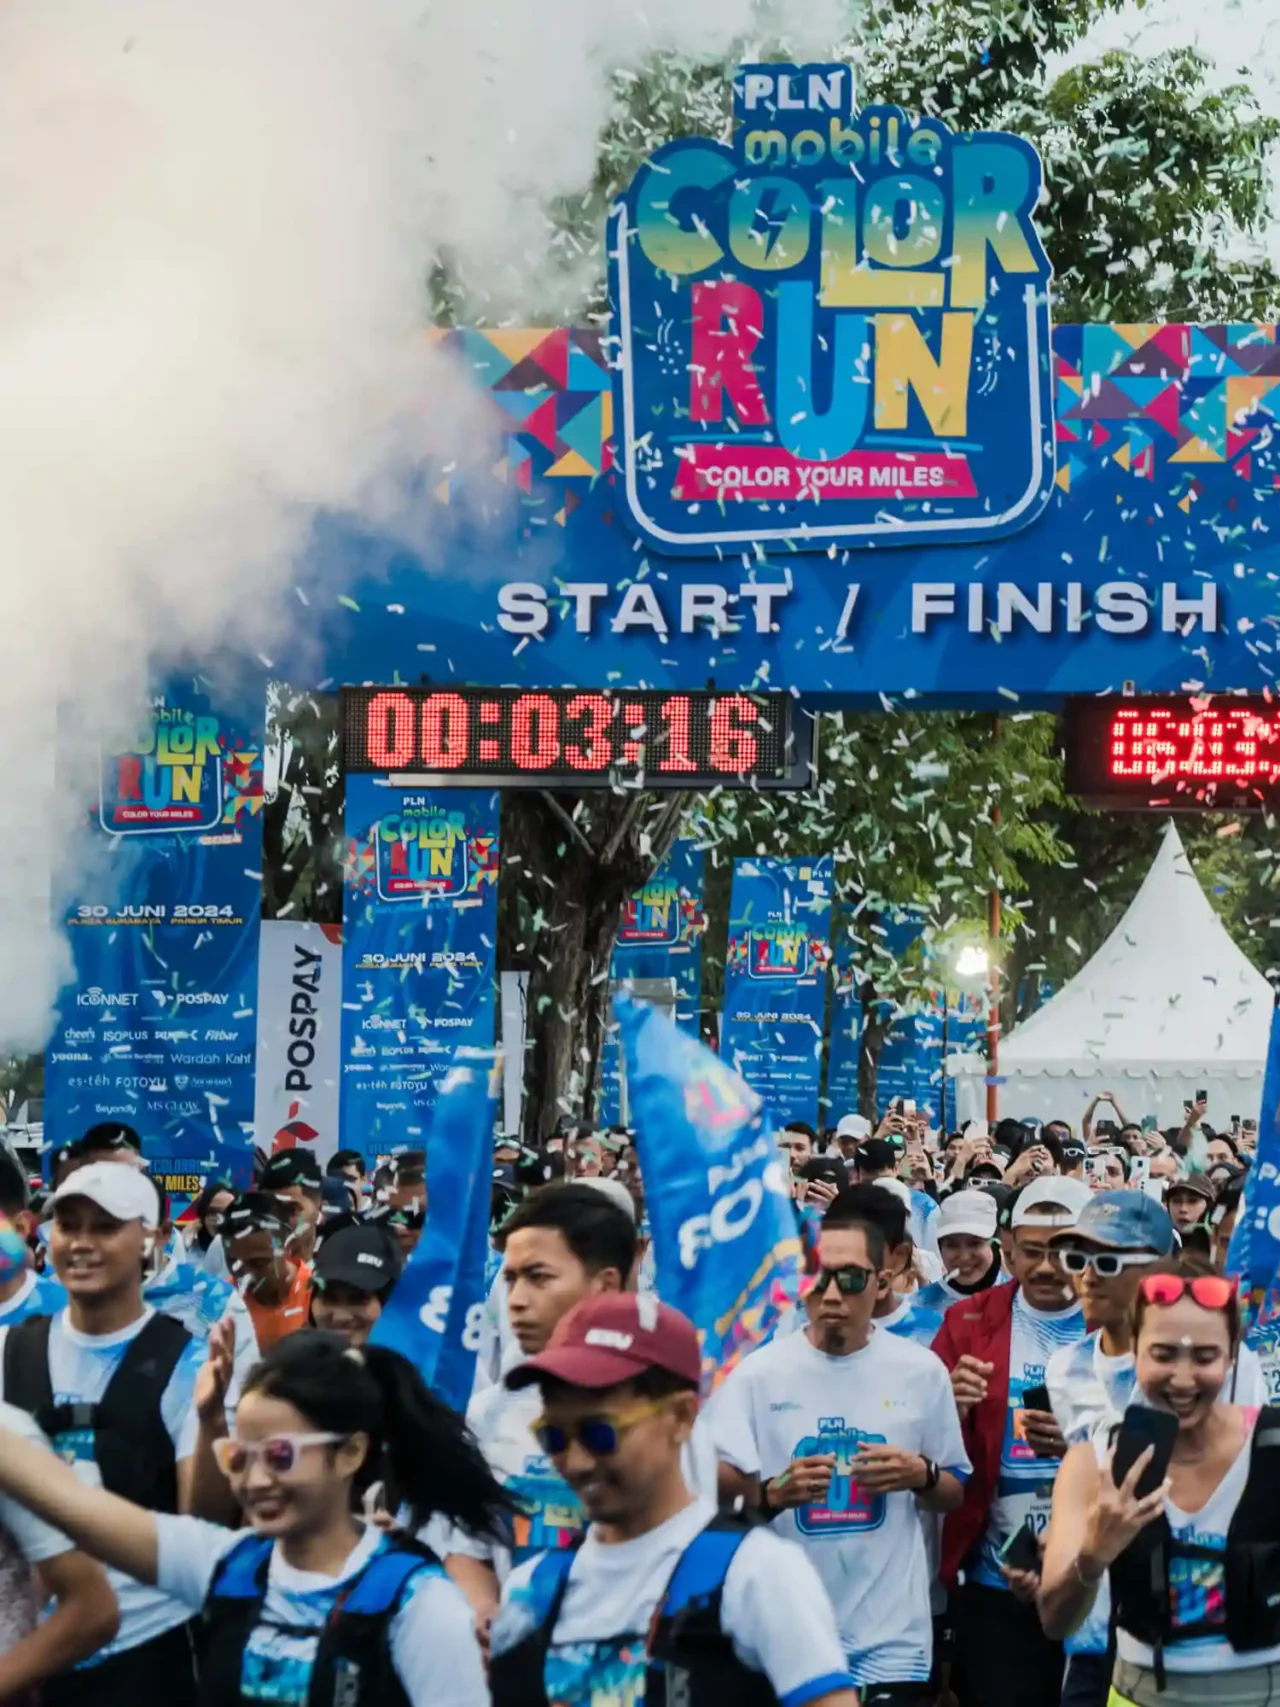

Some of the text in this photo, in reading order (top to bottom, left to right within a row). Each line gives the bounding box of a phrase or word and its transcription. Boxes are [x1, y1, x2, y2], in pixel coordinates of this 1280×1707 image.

[744, 70, 843, 111] PLN
[744, 116, 943, 167] mobile
[635, 142, 1040, 308] COLOR
[689, 280, 976, 462] RUN
[704, 465, 945, 488] COLOR YOUR MILES
[496, 582, 791, 635] START
[912, 581, 1218, 634] FINISH
[366, 692, 758, 772] 00:03:16
[118, 756, 203, 811] RUN
[403, 796, 426, 806] PLN
[379, 811, 467, 849] COLOR
[391, 841, 454, 882] RUN
[78, 905, 234, 918] 30 JUNI 2024
[390, 952, 426, 962] JUNI
[77, 993, 229, 1006] ICONNET POSPAY
[285, 943, 322, 1092] POSPAY
[103, 1030, 149, 1042] ISOPLUS
[171, 1053, 220, 1065] Wardah
[115, 1076, 167, 1088] FOTOYU
[165, 1174, 199, 1191] MILES
